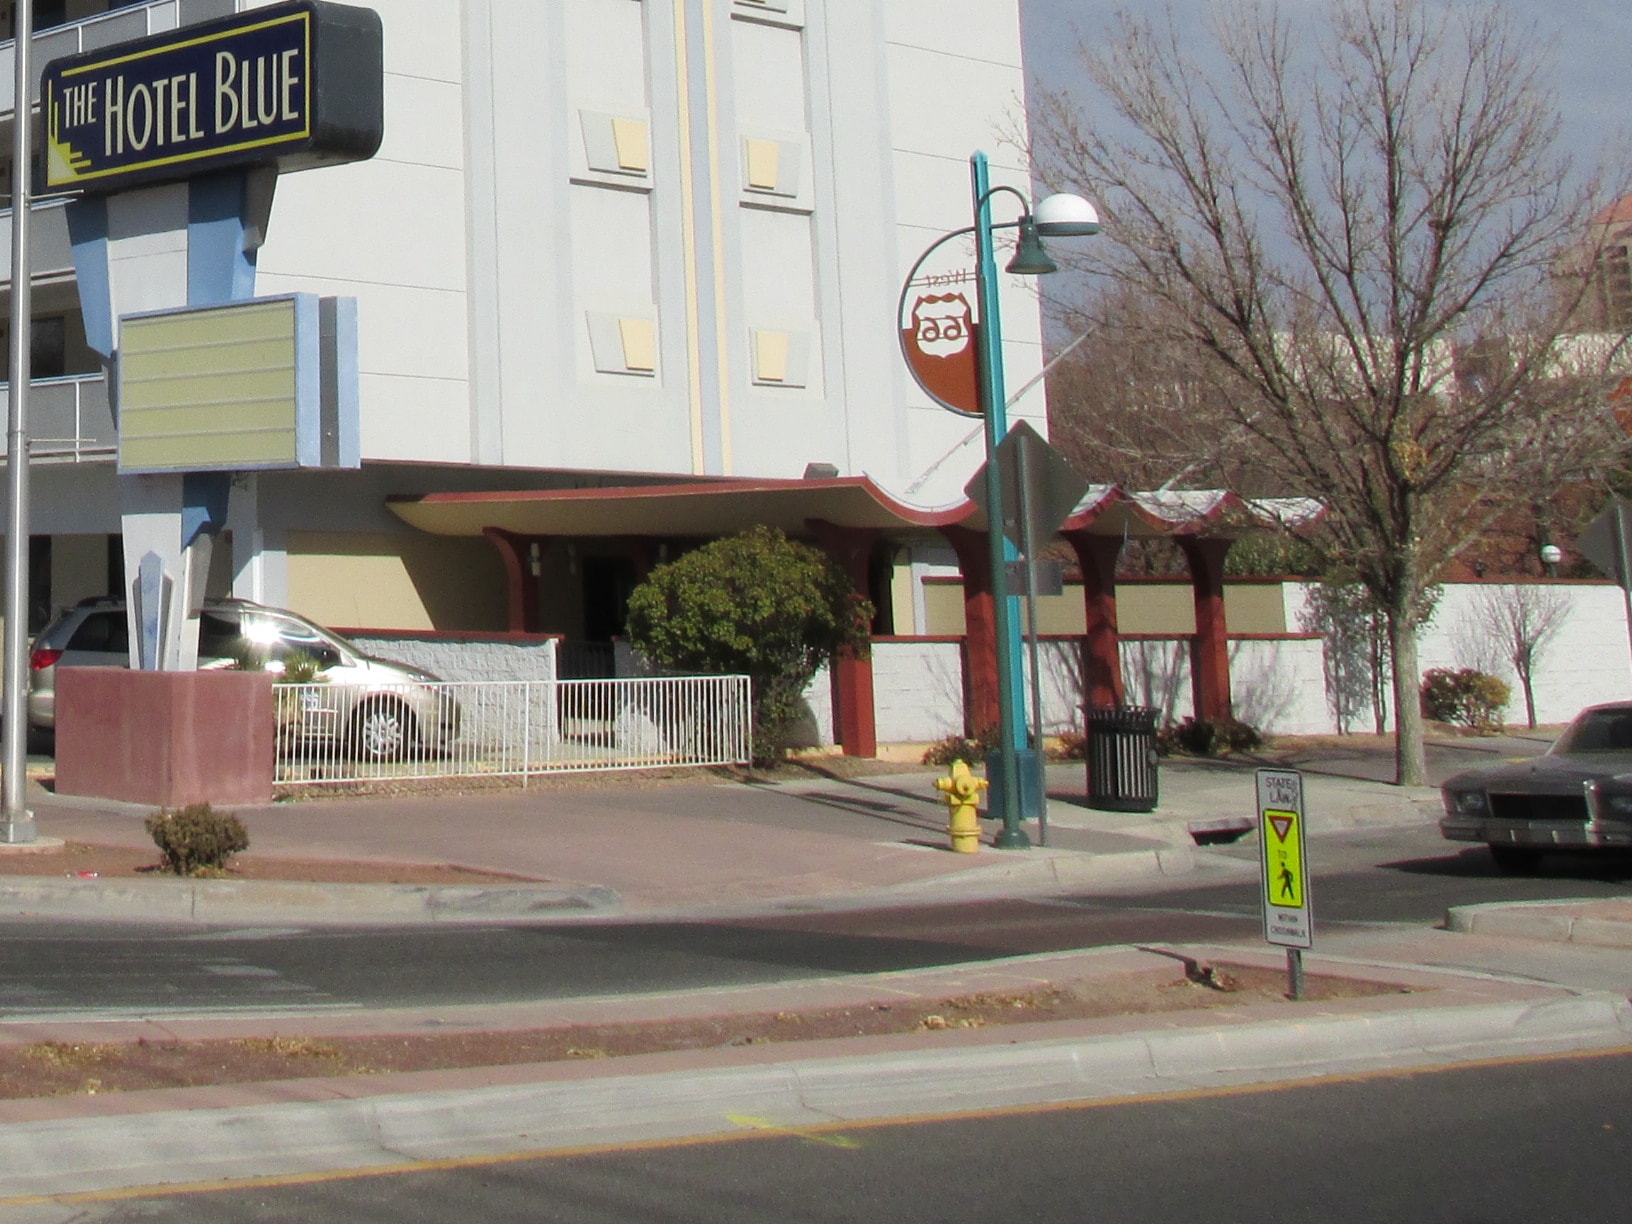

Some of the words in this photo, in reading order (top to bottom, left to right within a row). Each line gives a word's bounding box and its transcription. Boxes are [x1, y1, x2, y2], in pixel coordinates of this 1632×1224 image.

[63, 81, 98, 128] THE
[105, 72, 204, 156] HOTEL
[215, 48, 299, 134] BLUE
